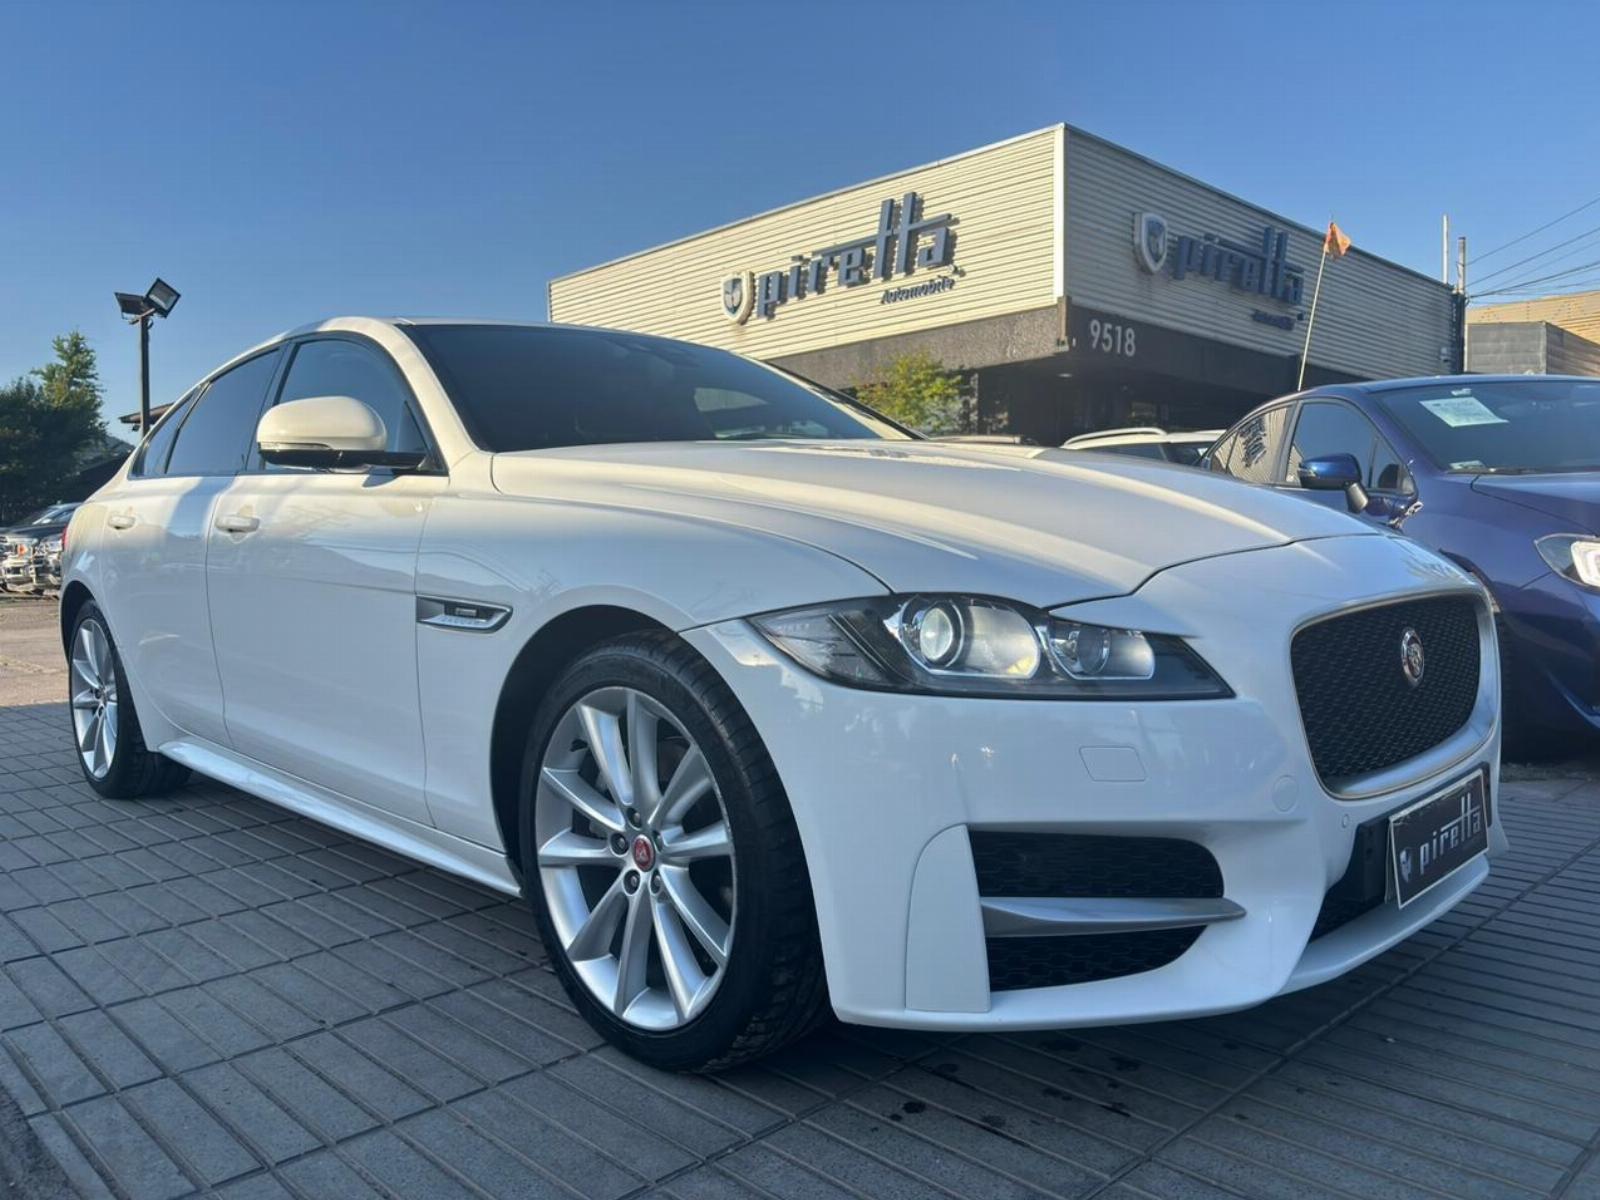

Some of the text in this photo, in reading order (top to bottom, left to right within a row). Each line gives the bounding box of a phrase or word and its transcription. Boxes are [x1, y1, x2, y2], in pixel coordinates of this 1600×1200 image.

[756, 192, 956, 319] piretta
[1090, 319, 1136, 357] 9518
[1420, 792, 1481, 875] piretta
